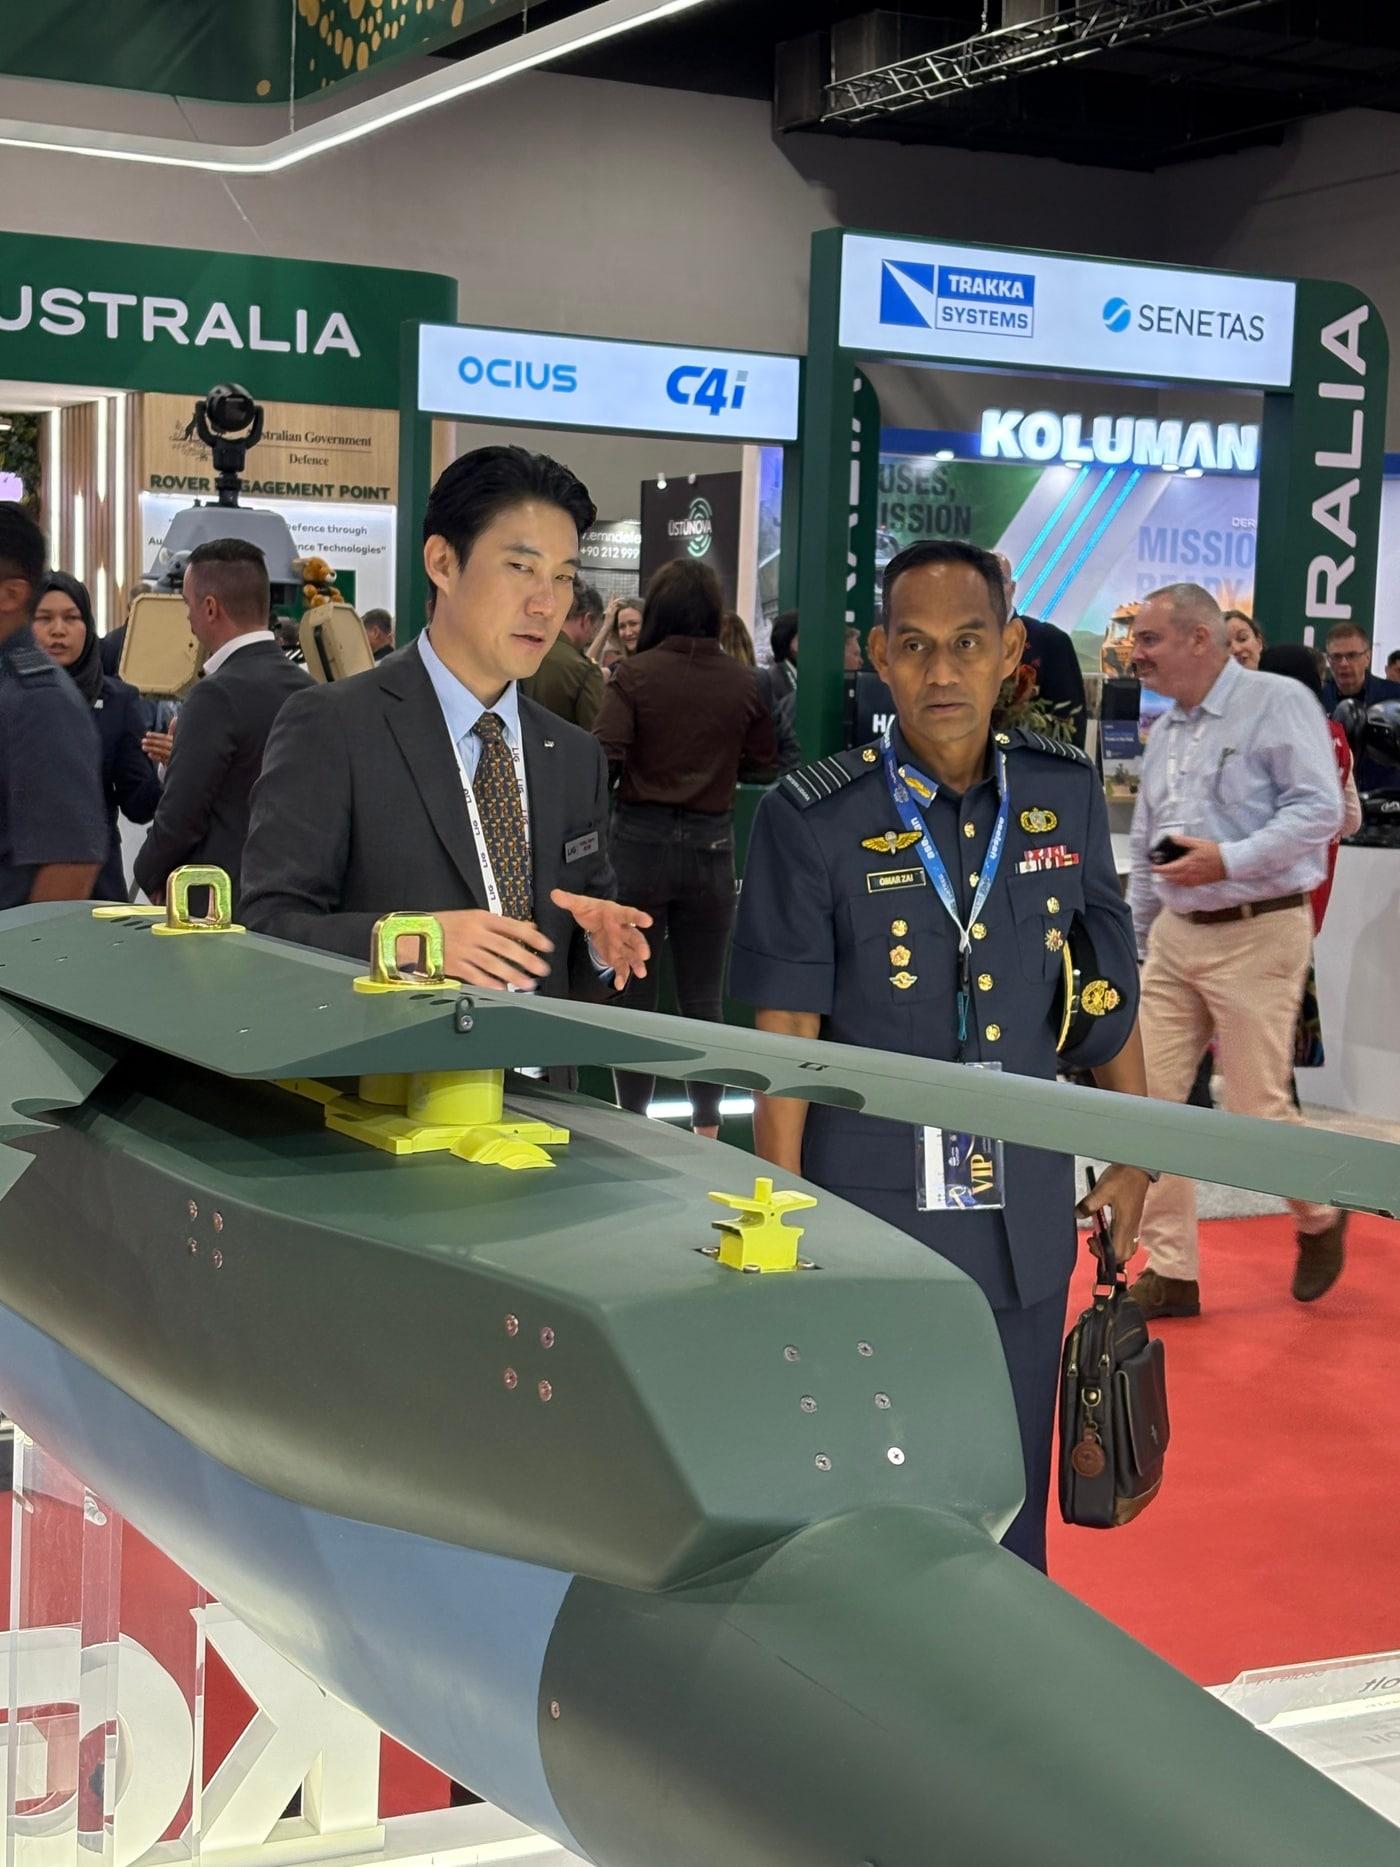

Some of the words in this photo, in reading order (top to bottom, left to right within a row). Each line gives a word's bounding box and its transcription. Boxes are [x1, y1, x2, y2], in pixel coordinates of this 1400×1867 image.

[948, 274, 1024, 299] TRAKKA
[0, 285, 361, 358] USTRALIA
[942, 306, 1028, 330] SYSTEMS
[1138, 304, 1265, 341] SENETAS
[458, 355, 577, 393] OCIUS
[666, 365, 749, 416] C4i
[305, 431, 371, 446] Government
[980, 408, 1260, 471] KOLUMAN
[289, 453, 329, 466] Defence
[151, 475, 210, 491] ROVER
[215, 478, 335, 498] EGAGEMENT
[340, 485, 391, 500] POINT
[1304, 305, 1369, 648] RALIA
[327, 525, 368, 537] through
[581, 546, 599, 558] +90
[601, 546, 619, 558] 212
[971, 1154, 993, 1195] VIP
